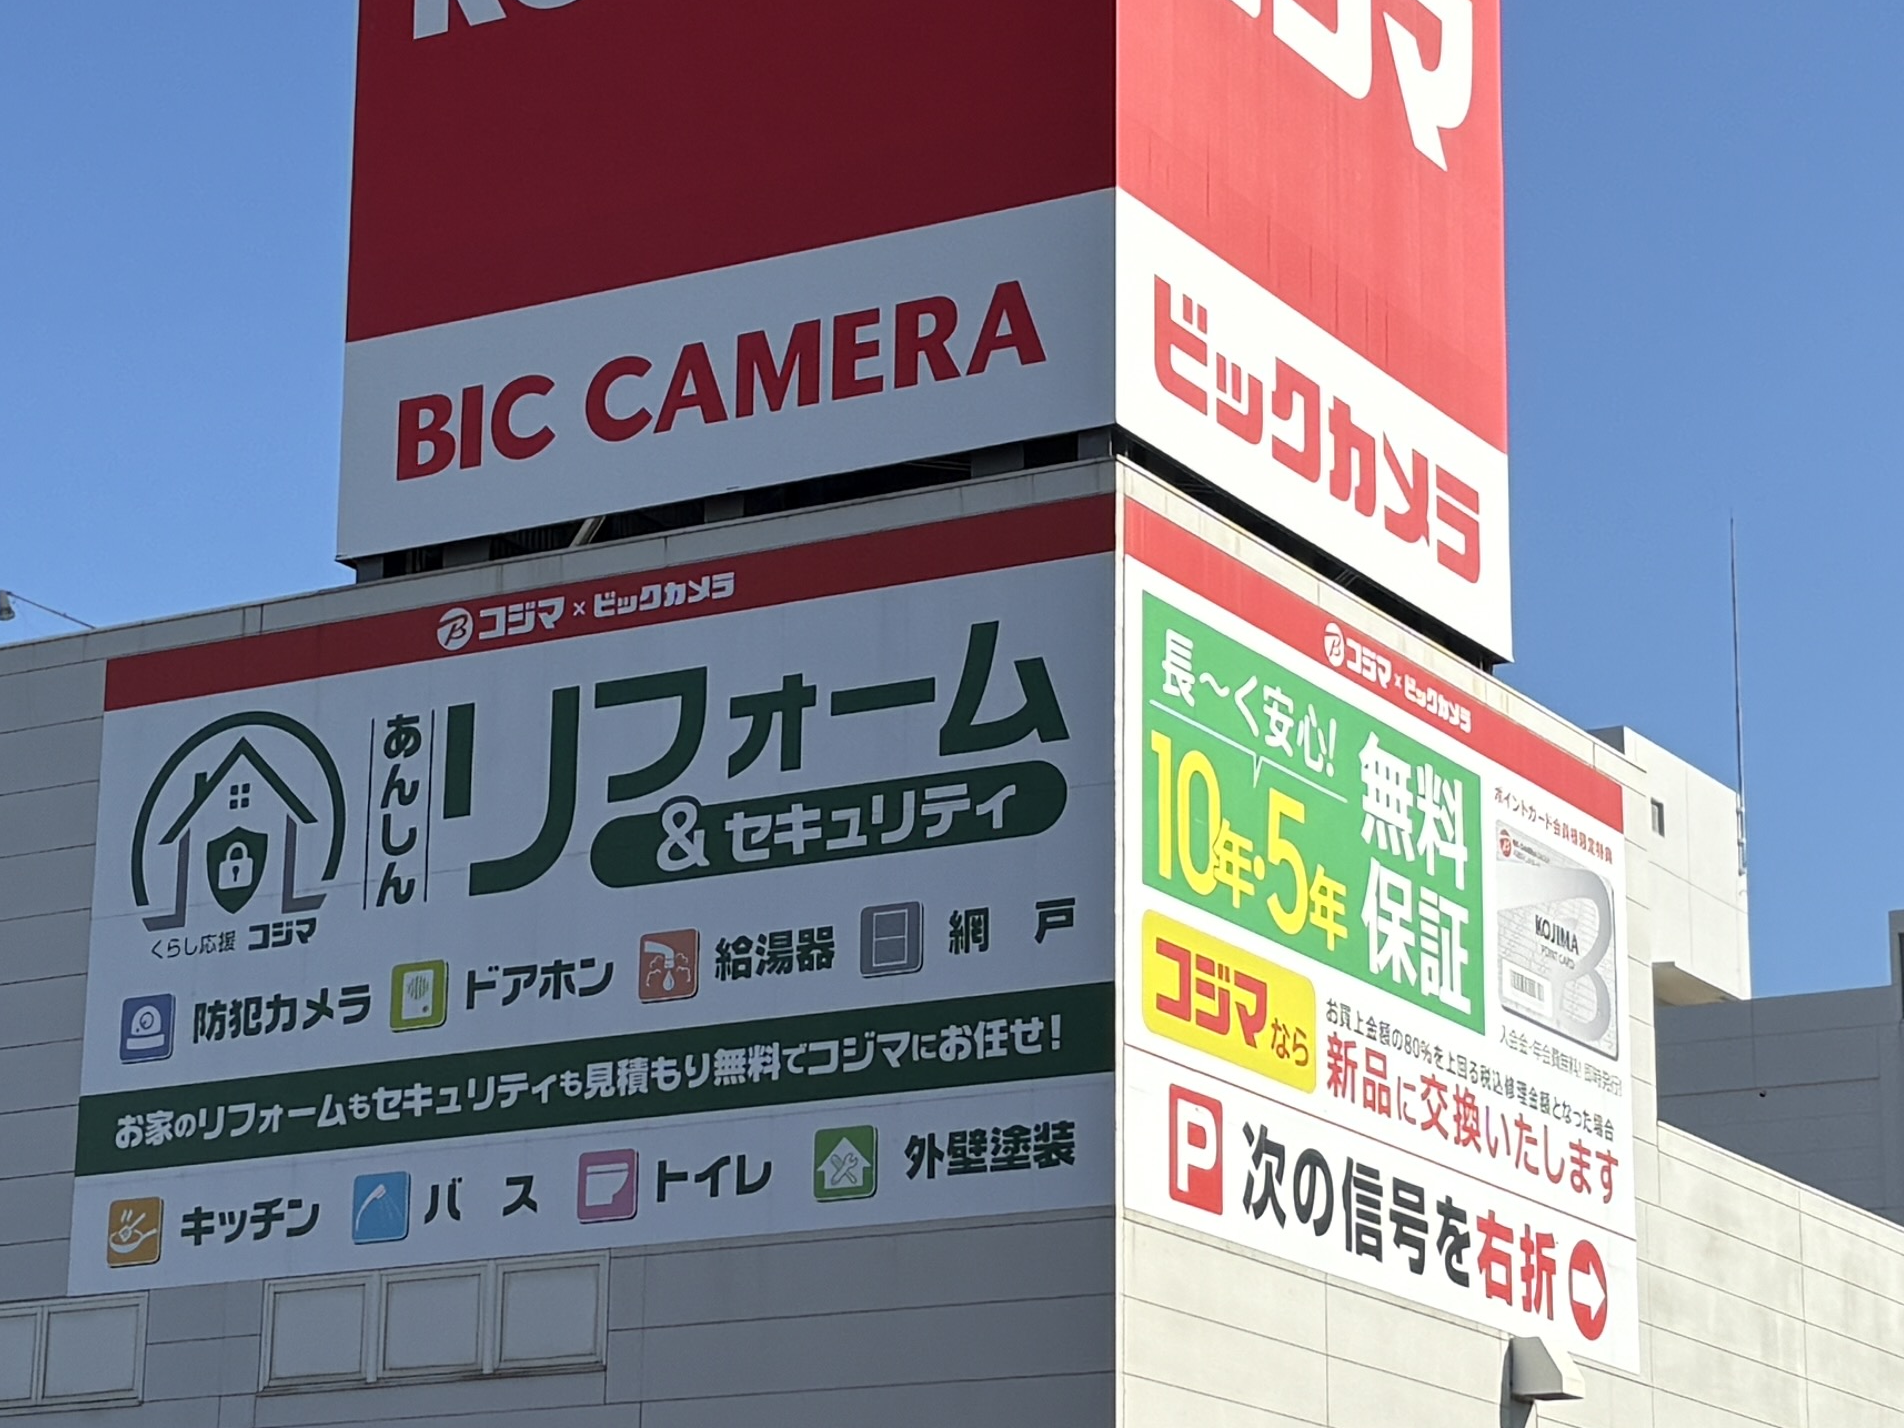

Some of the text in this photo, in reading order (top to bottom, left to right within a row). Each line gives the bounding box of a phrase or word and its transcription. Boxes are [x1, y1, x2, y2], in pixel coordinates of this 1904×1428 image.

[395, 278, 1048, 482] BIC CAMERA
[1152, 273, 1482, 584] ビックカメラ
[375, 714, 422, 908] あんしん
[442, 619, 1071, 897] リフォーム
[1359, 730, 1469, 891] 無料
[150, 917, 317, 959] くらし応援 コジマ
[192, 984, 372, 1044] 防犯カメラ
[465, 957, 615, 1010] ドアホン
[714, 925, 835, 981] 給湯器
[1360, 856, 1472, 1017] 保証
[1534, 913, 1580, 957] KOJIMA
[180, 1193, 322, 1248] キッチン
[655, 1153, 773, 1203] トイレ
[903, 1120, 1076, 1181] 外壁塗装
[1326, 1031, 1619, 1205] 新品に交換いたします
[1175, 1093, 1558, 1322] P 次の信号を右折
